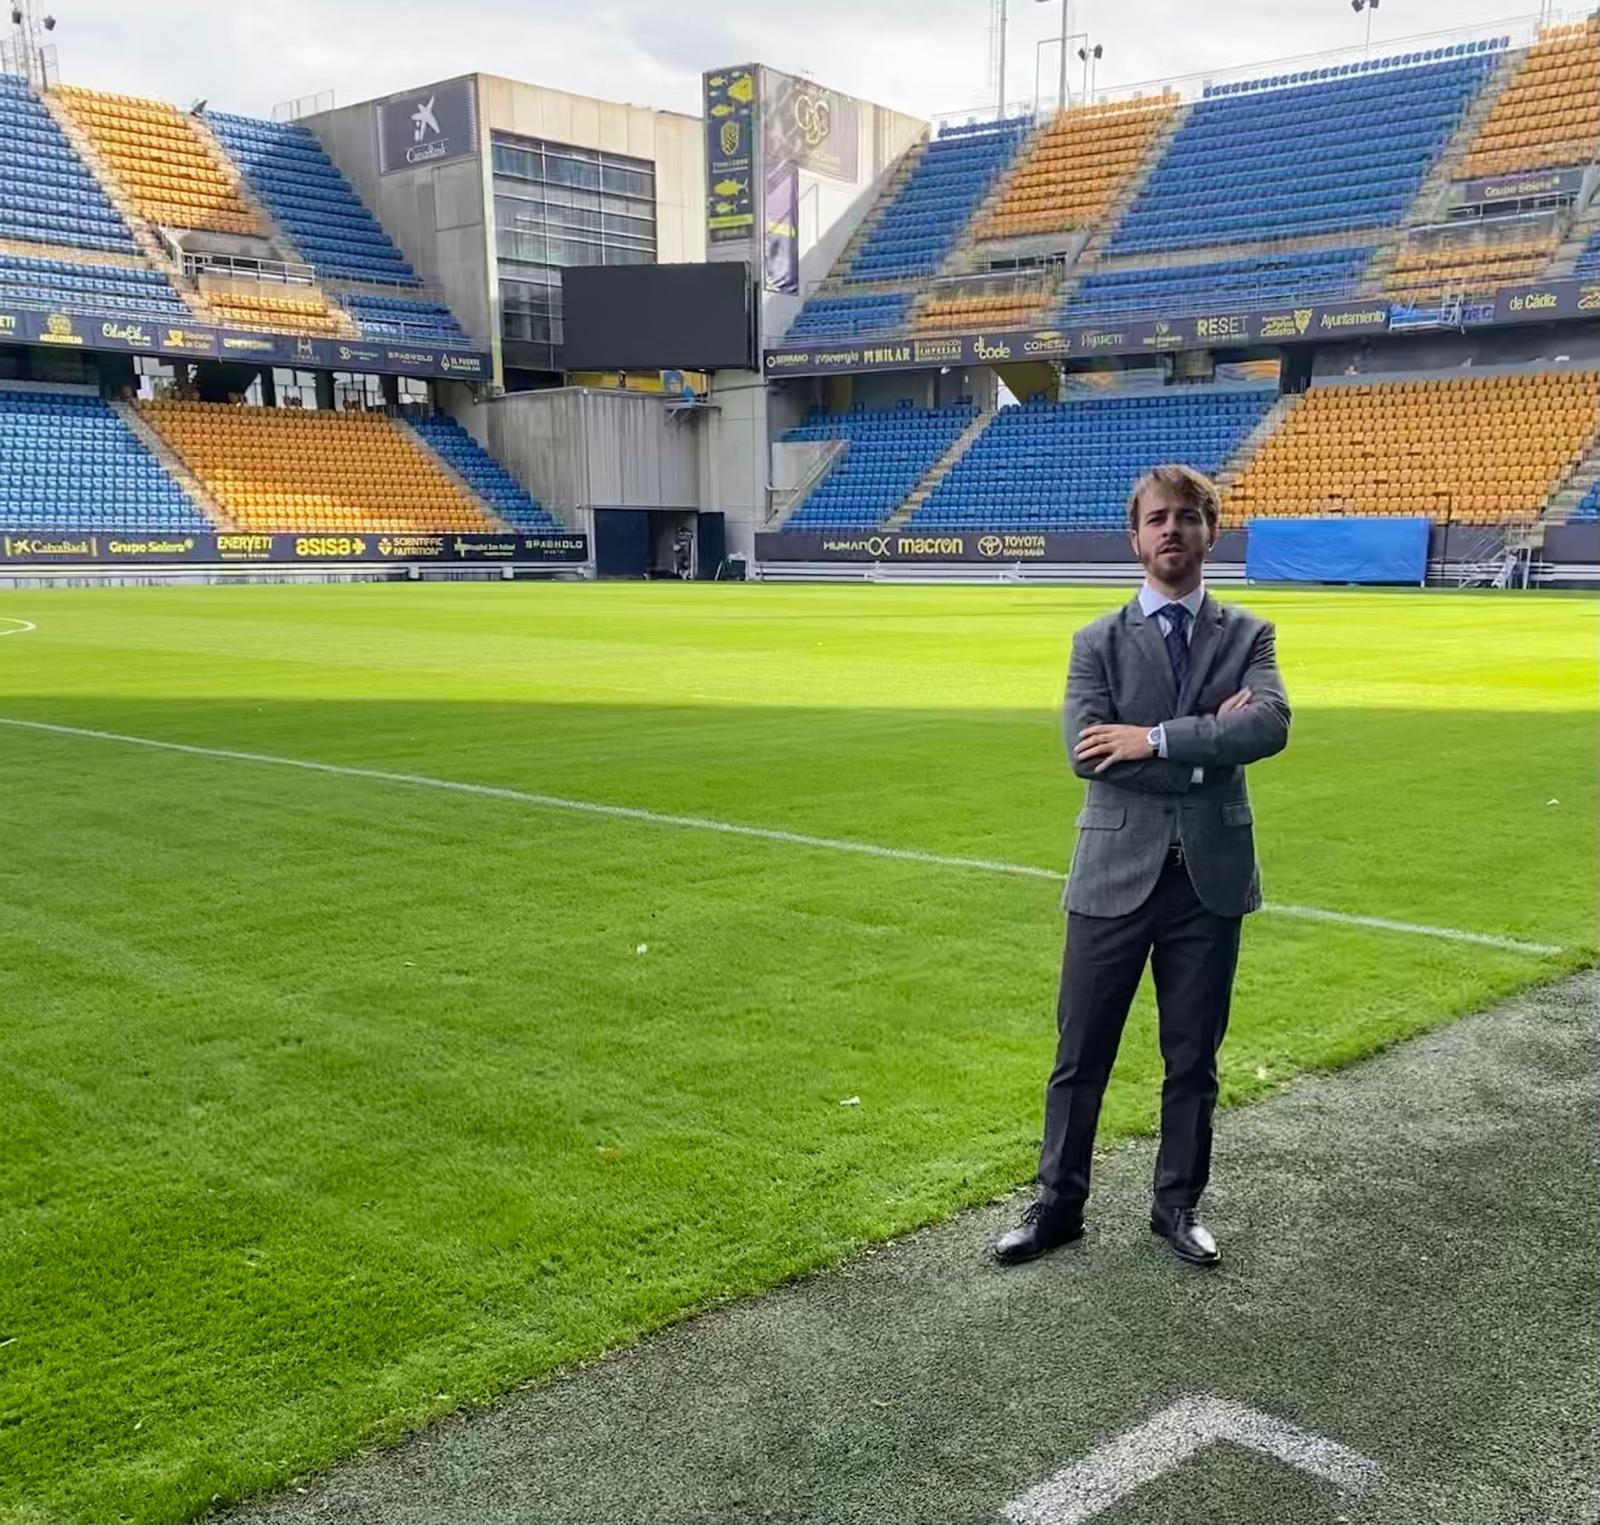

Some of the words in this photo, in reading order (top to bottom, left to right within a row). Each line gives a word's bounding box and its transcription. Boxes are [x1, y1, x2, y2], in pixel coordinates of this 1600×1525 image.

[1510, 298, 1523, 310] de
[1197, 315, 1249, 336] RESET
[1320, 311, 1386, 329] Ayuntamiento
[109, 541, 147, 555] Grupo
[296, 538, 351, 556] asisa
[897, 538, 963, 554] macron
[1003, 535, 1045, 547] TOYOTA
